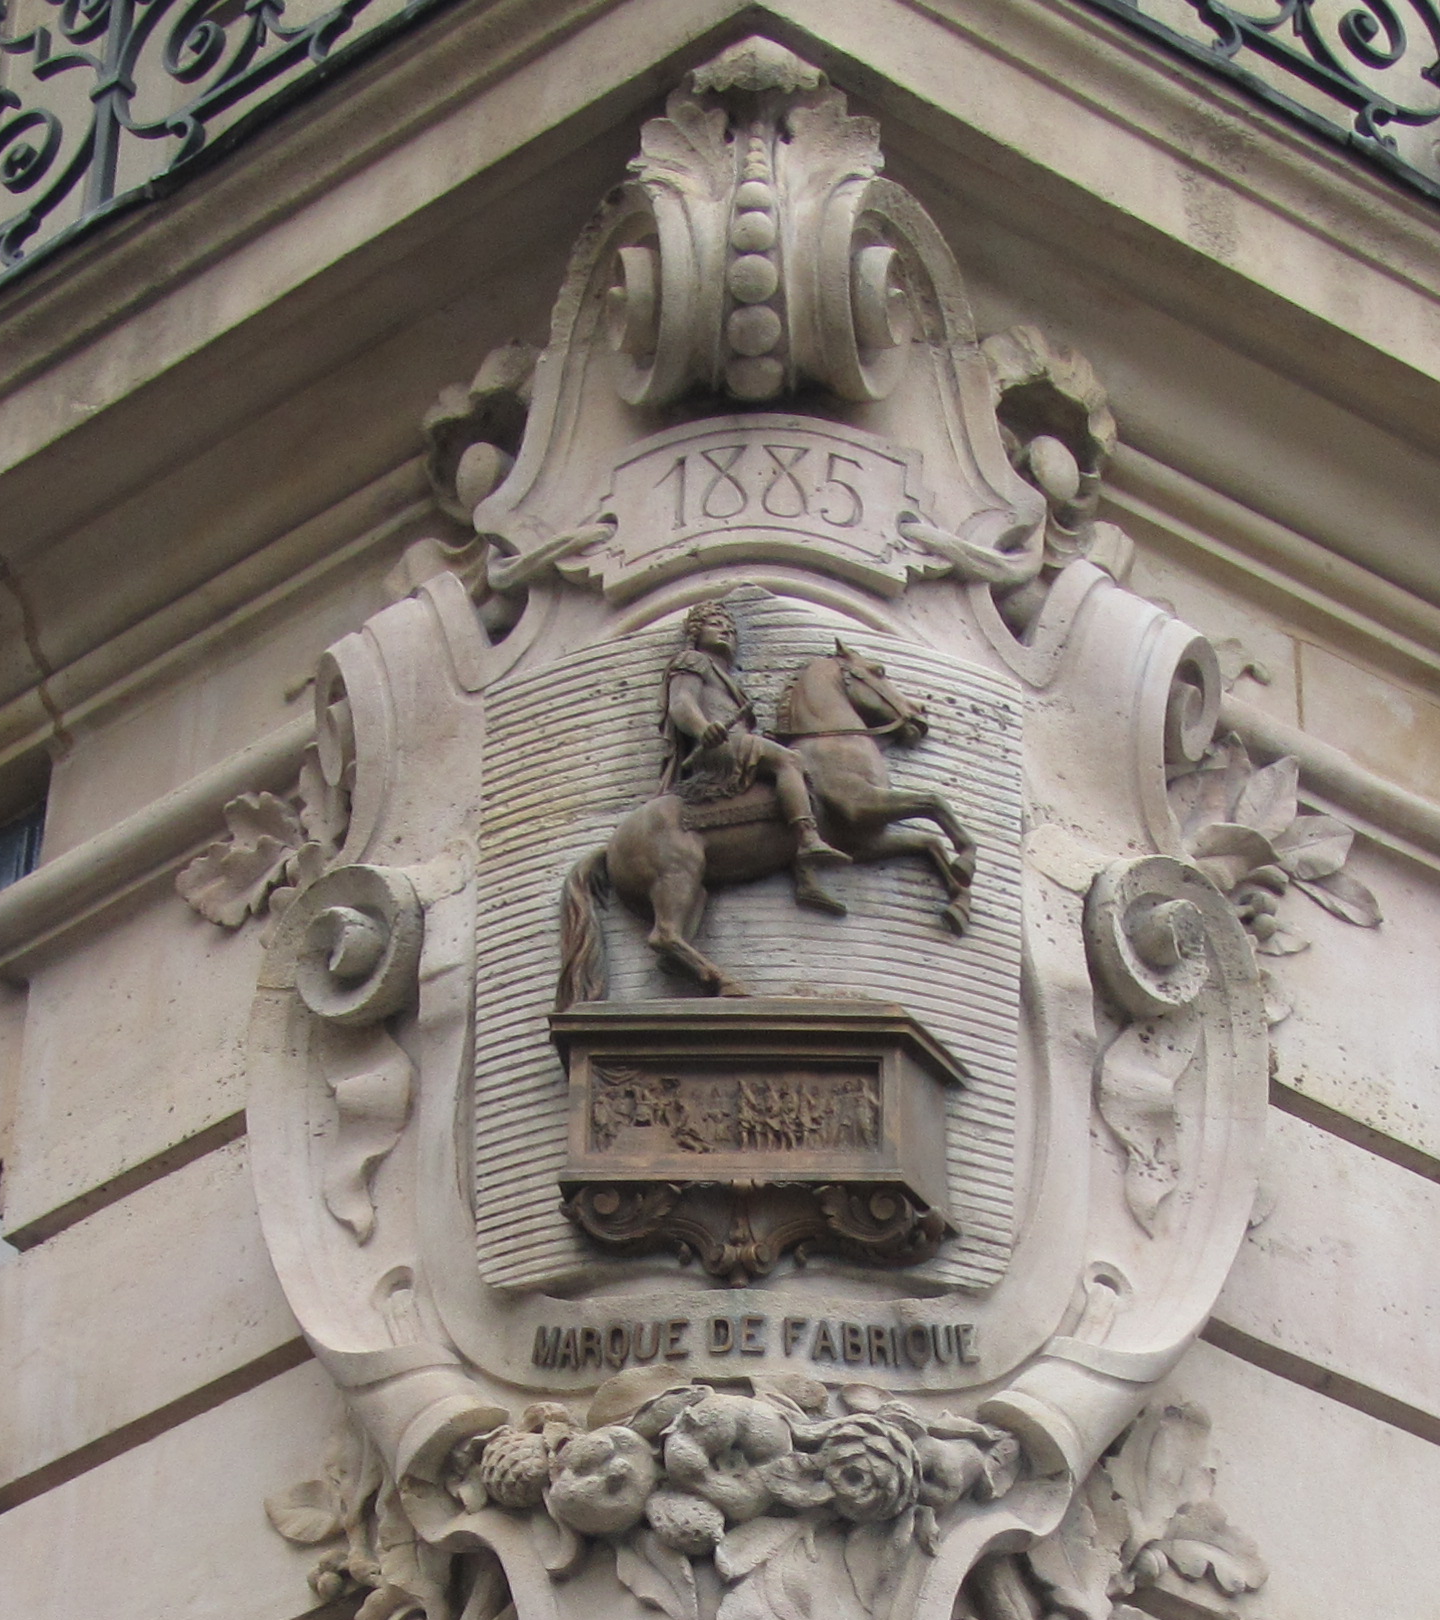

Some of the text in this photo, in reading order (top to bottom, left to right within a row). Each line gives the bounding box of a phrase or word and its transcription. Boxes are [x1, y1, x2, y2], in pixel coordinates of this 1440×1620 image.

[654, 444, 865, 529] 1885
[531, 1315, 980, 1370] MARQUE DE FABRIQUE
